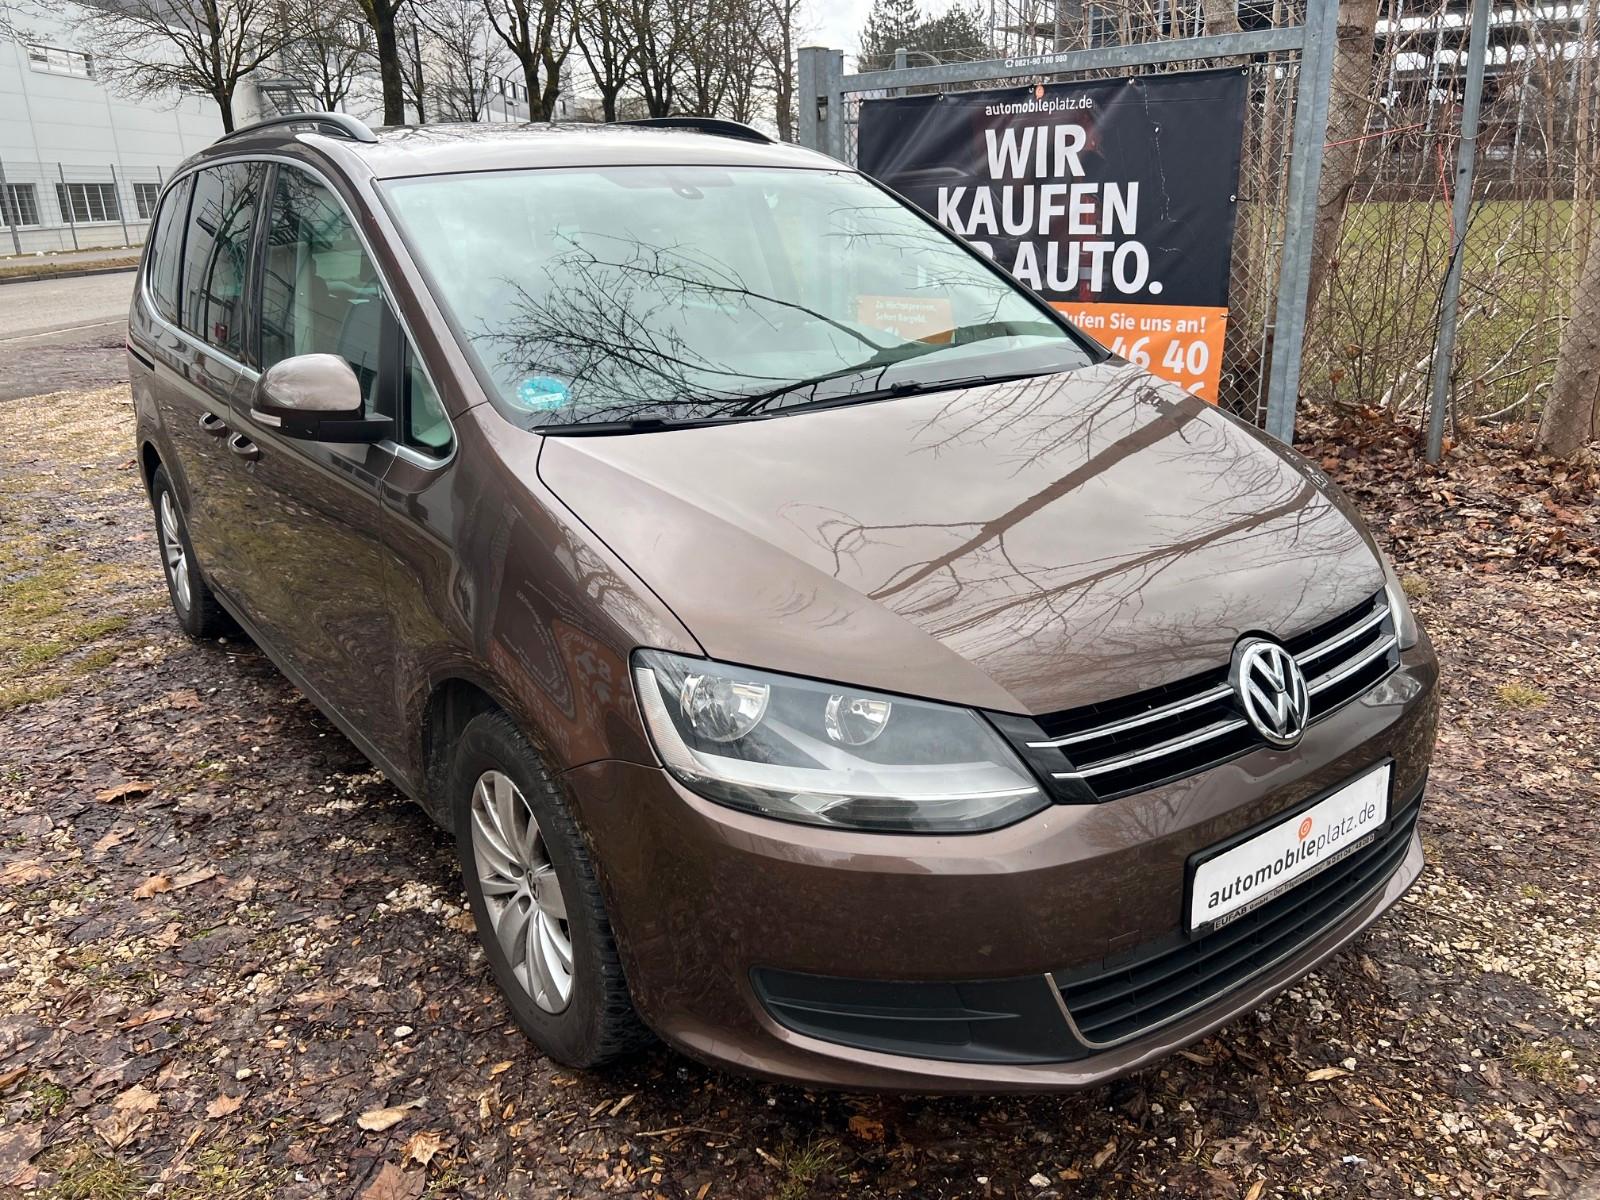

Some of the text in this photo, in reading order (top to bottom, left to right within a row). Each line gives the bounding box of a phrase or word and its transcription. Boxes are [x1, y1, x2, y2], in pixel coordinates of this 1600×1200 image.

[985, 95, 1093, 116] automobileplatz.de
[985, 124, 1087, 179] WIR
[937, 181, 1140, 236] KAUFEN
[1012, 240, 1164, 295] AUTO.
[1110, 312, 1136, 330] Sie
[1140, 316, 1171, 332] uns
[1175, 317, 1206, 333] an!
[1162, 340, 1210, 376] 40
[1207, 801, 1377, 909] automobileplatz.de
[1215, 906, 1248, 929] EUFAB
